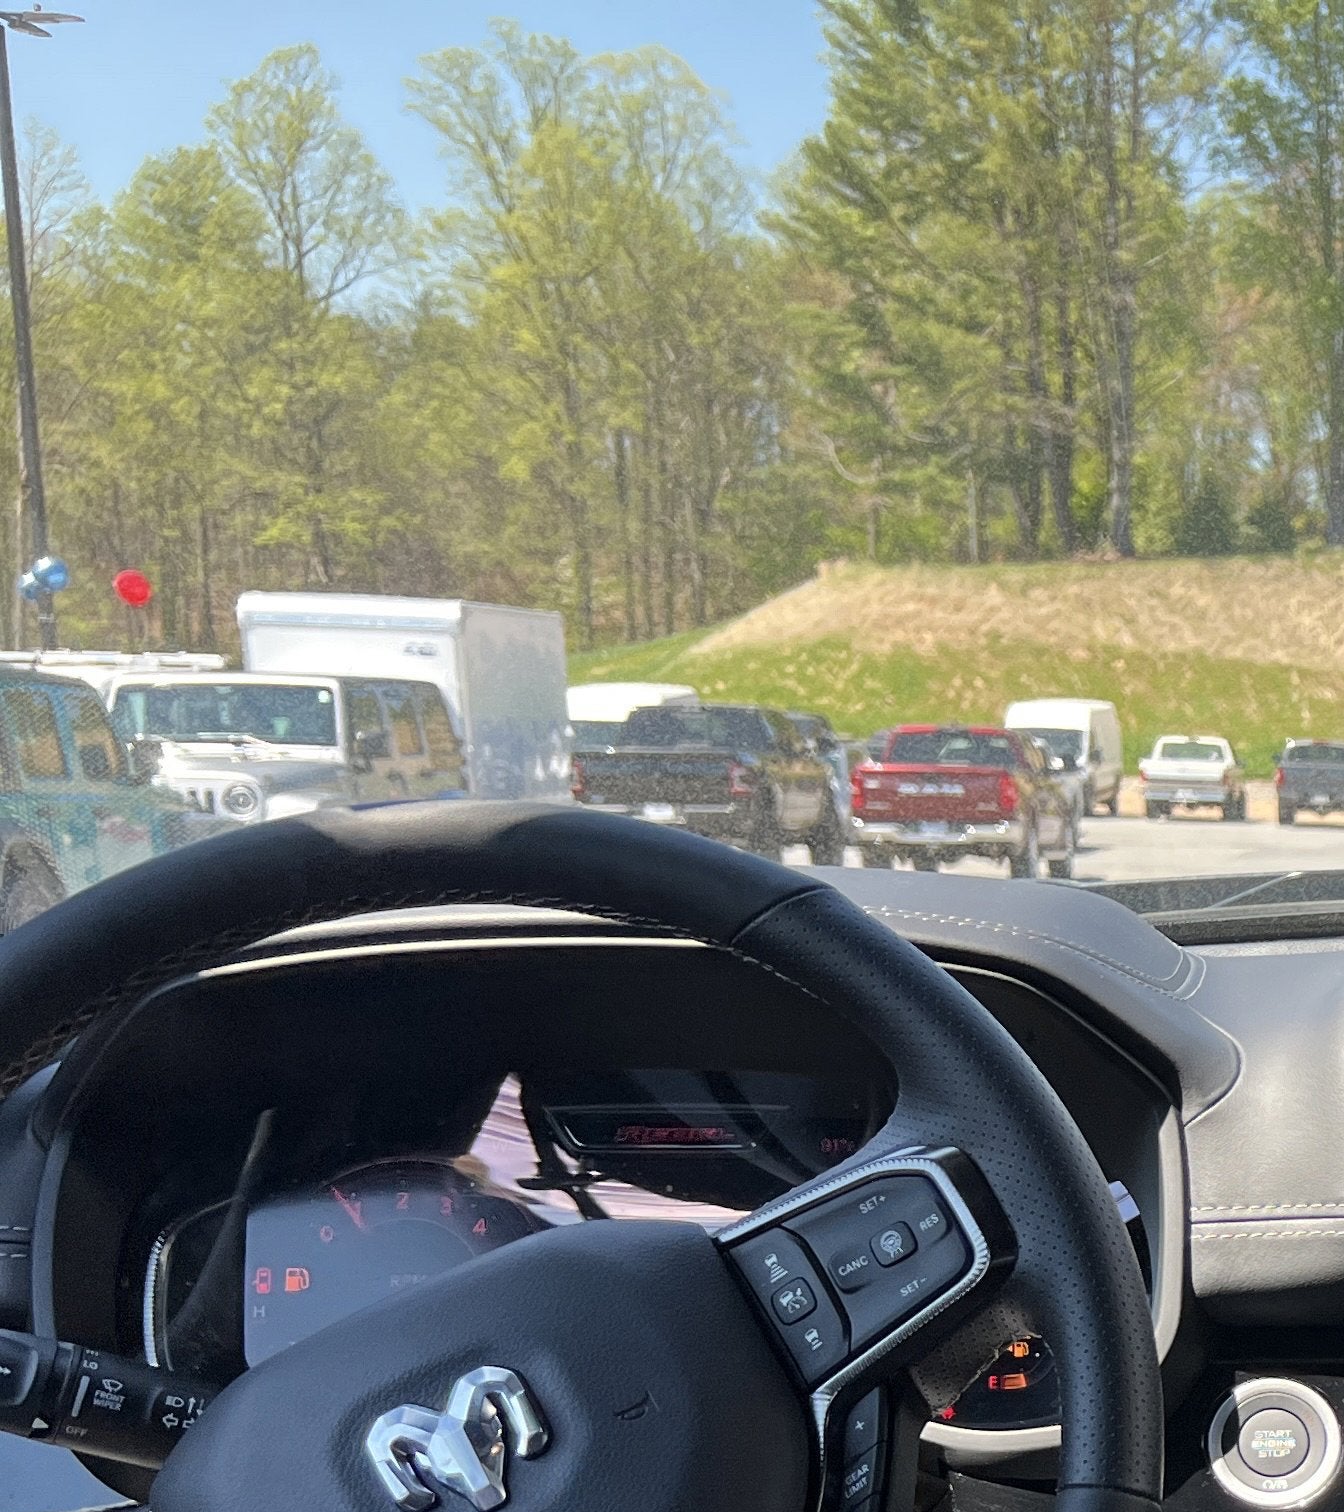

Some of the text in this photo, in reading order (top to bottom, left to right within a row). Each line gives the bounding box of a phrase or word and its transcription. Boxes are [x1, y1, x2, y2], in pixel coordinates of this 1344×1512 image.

[472, 1218, 488, 1234] 4
[919, 1213, 939, 1231] RES
[838, 1255, 869, 1276] CANC
[253, 1305, 266, 1318] H
[94, 1389, 126, 1403] FRONT
[65, 1424, 89, 1437] OFF
[1254, 1429, 1292, 1439] START
[1251, 1439, 1296, 1449] ENGINE
[1258, 1449, 1291, 1459] STOP
[845, 1463, 870, 1486] GEAR
[844, 1477, 868, 1499] LIMIT
